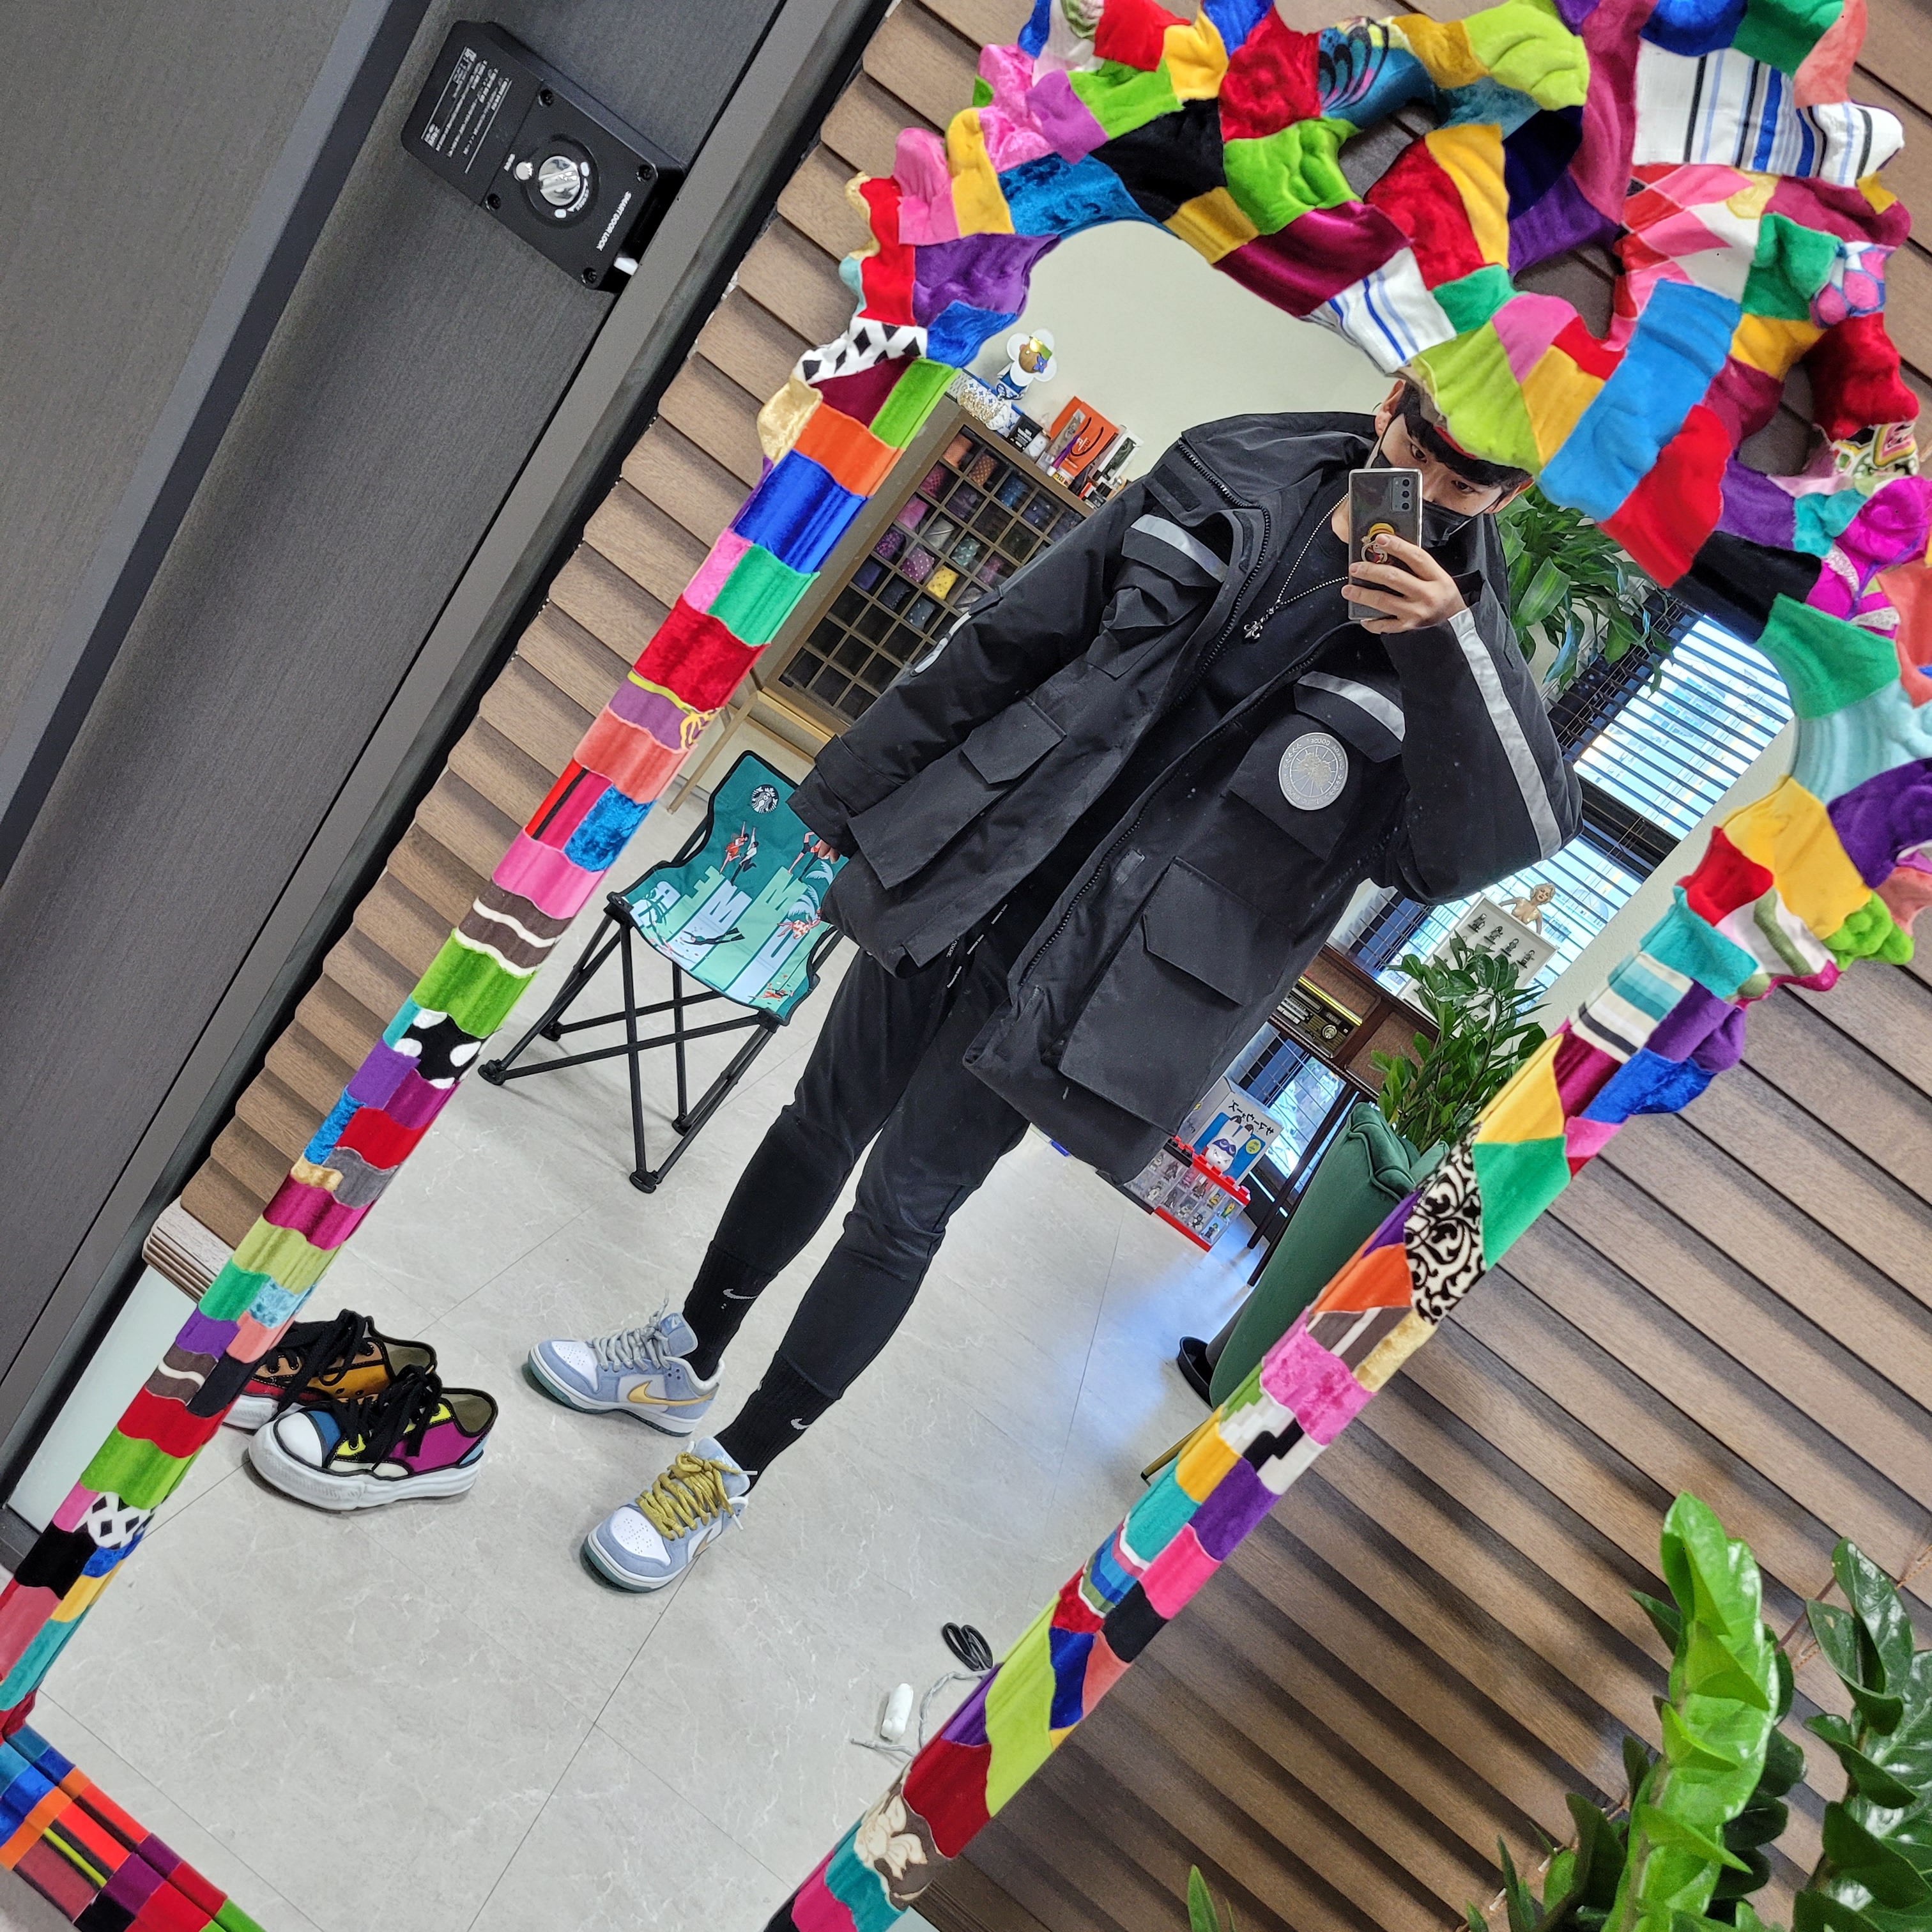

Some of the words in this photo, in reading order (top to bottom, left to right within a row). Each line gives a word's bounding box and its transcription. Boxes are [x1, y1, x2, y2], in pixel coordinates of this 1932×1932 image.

[616, 191, 631, 216] SMART
[605, 213, 620, 234] DOOR
[596, 231, 610, 251] LOCK
